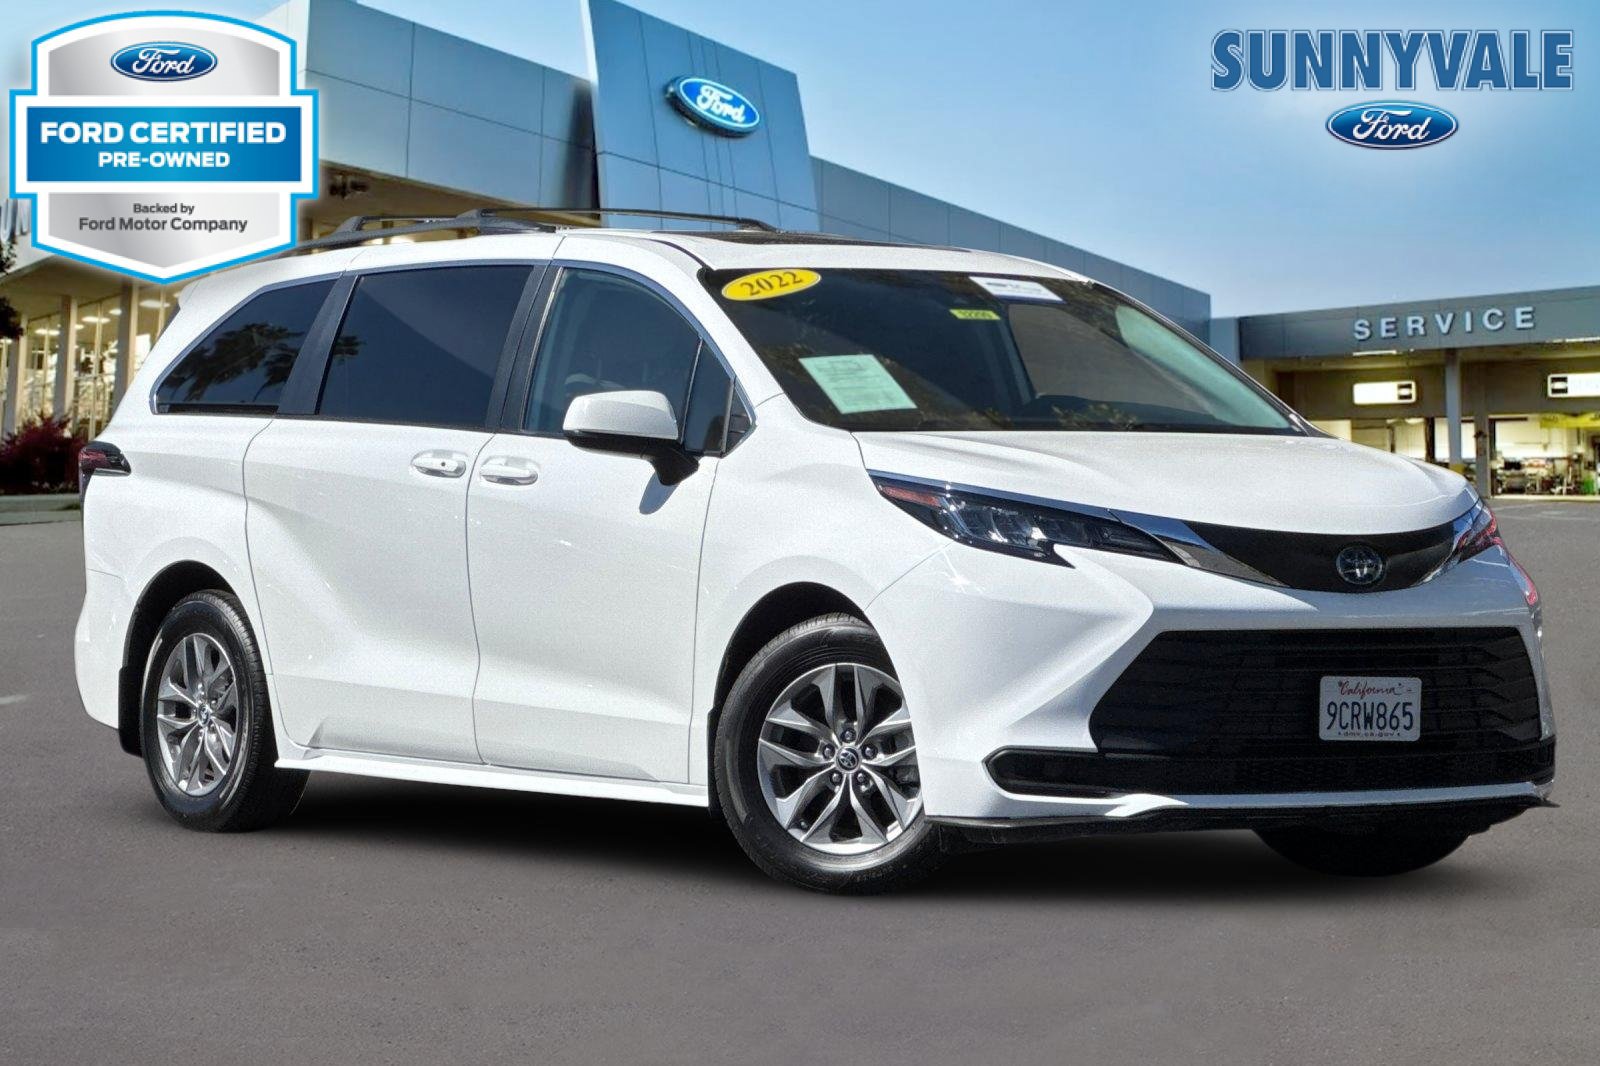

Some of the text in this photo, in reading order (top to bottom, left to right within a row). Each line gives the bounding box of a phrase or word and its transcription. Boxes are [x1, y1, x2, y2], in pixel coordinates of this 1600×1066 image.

[697, 85, 746, 123] Ford
[740, 271, 804, 296] 2022
[1353, 305, 1536, 341] SERVICE
[1339, 680, 1402, 699] California
[1327, 701, 1414, 730] 9CRW865
